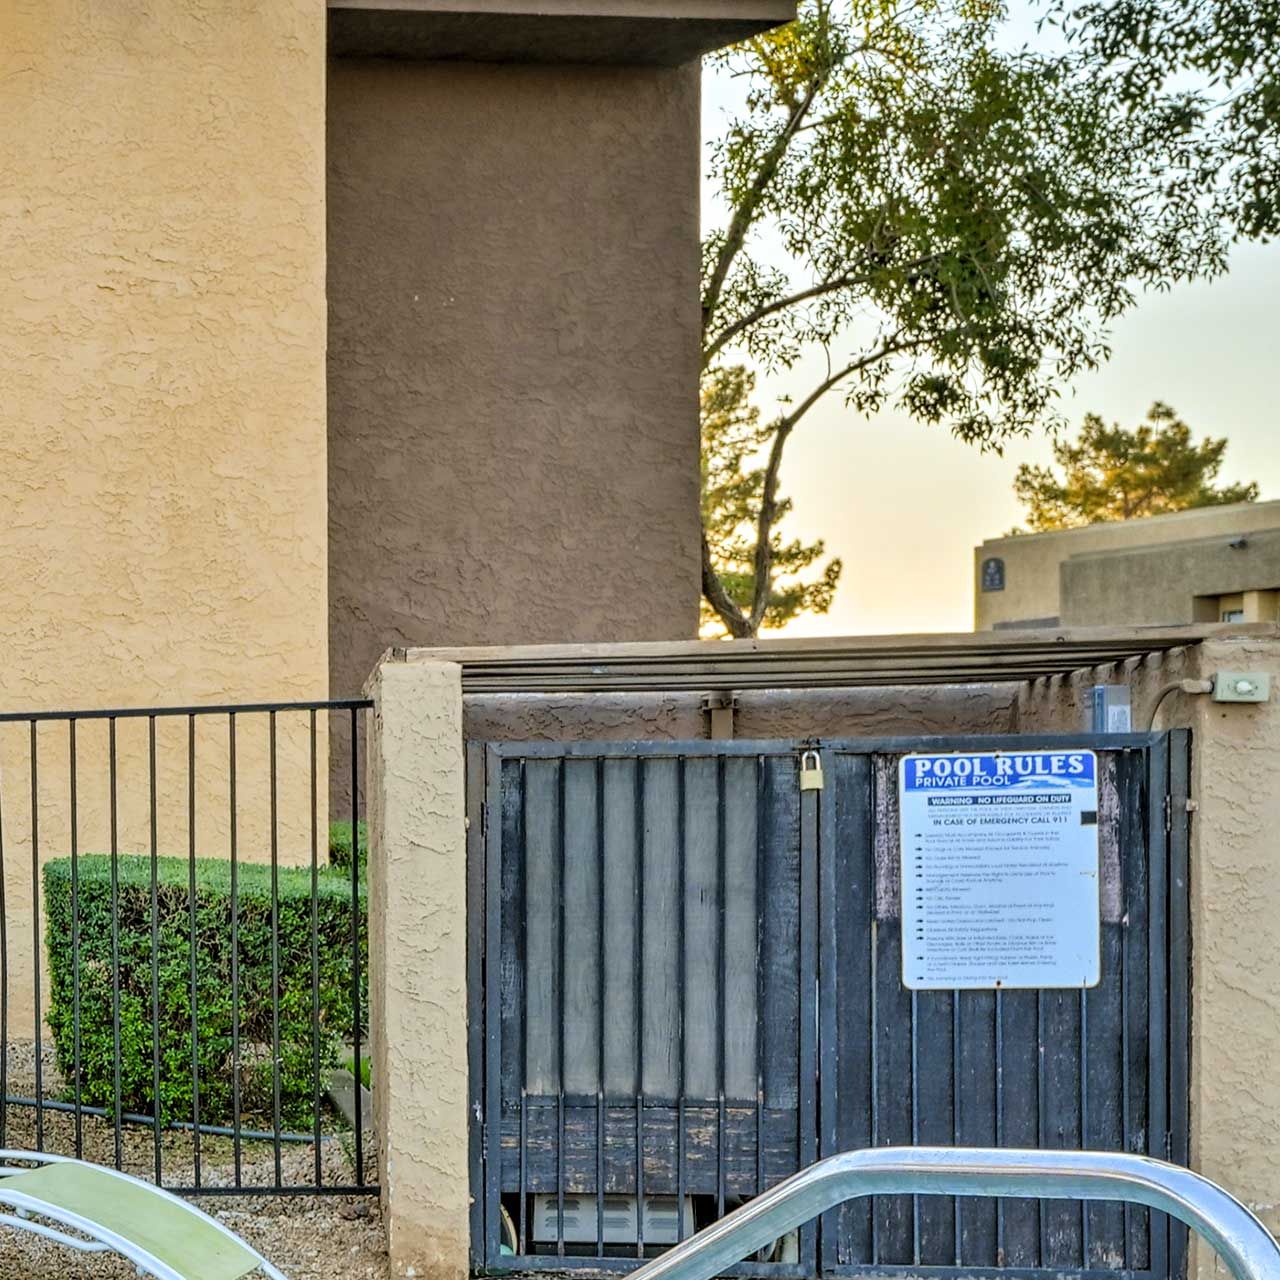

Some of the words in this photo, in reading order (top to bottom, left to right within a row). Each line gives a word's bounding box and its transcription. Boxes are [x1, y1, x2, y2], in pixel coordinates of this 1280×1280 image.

[915, 758, 986, 777] POOL
[996, 755, 1084, 775] RULES
[915, 776, 967, 788] PRIVATE
[972, 775, 1010, 786] POOL
[931, 797, 973, 805] WARNING
[978, 796, 991, 805] NO
[992, 795, 1034, 804] LIFEGUARD
[1035, 795, 1049, 803] ON
[1050, 794, 1070, 803] DUTY
[980, 816, 1029, 825] EMERGENCY
[1031, 816, 1050, 824] CALL
[1053, 816, 1068, 824] 911
